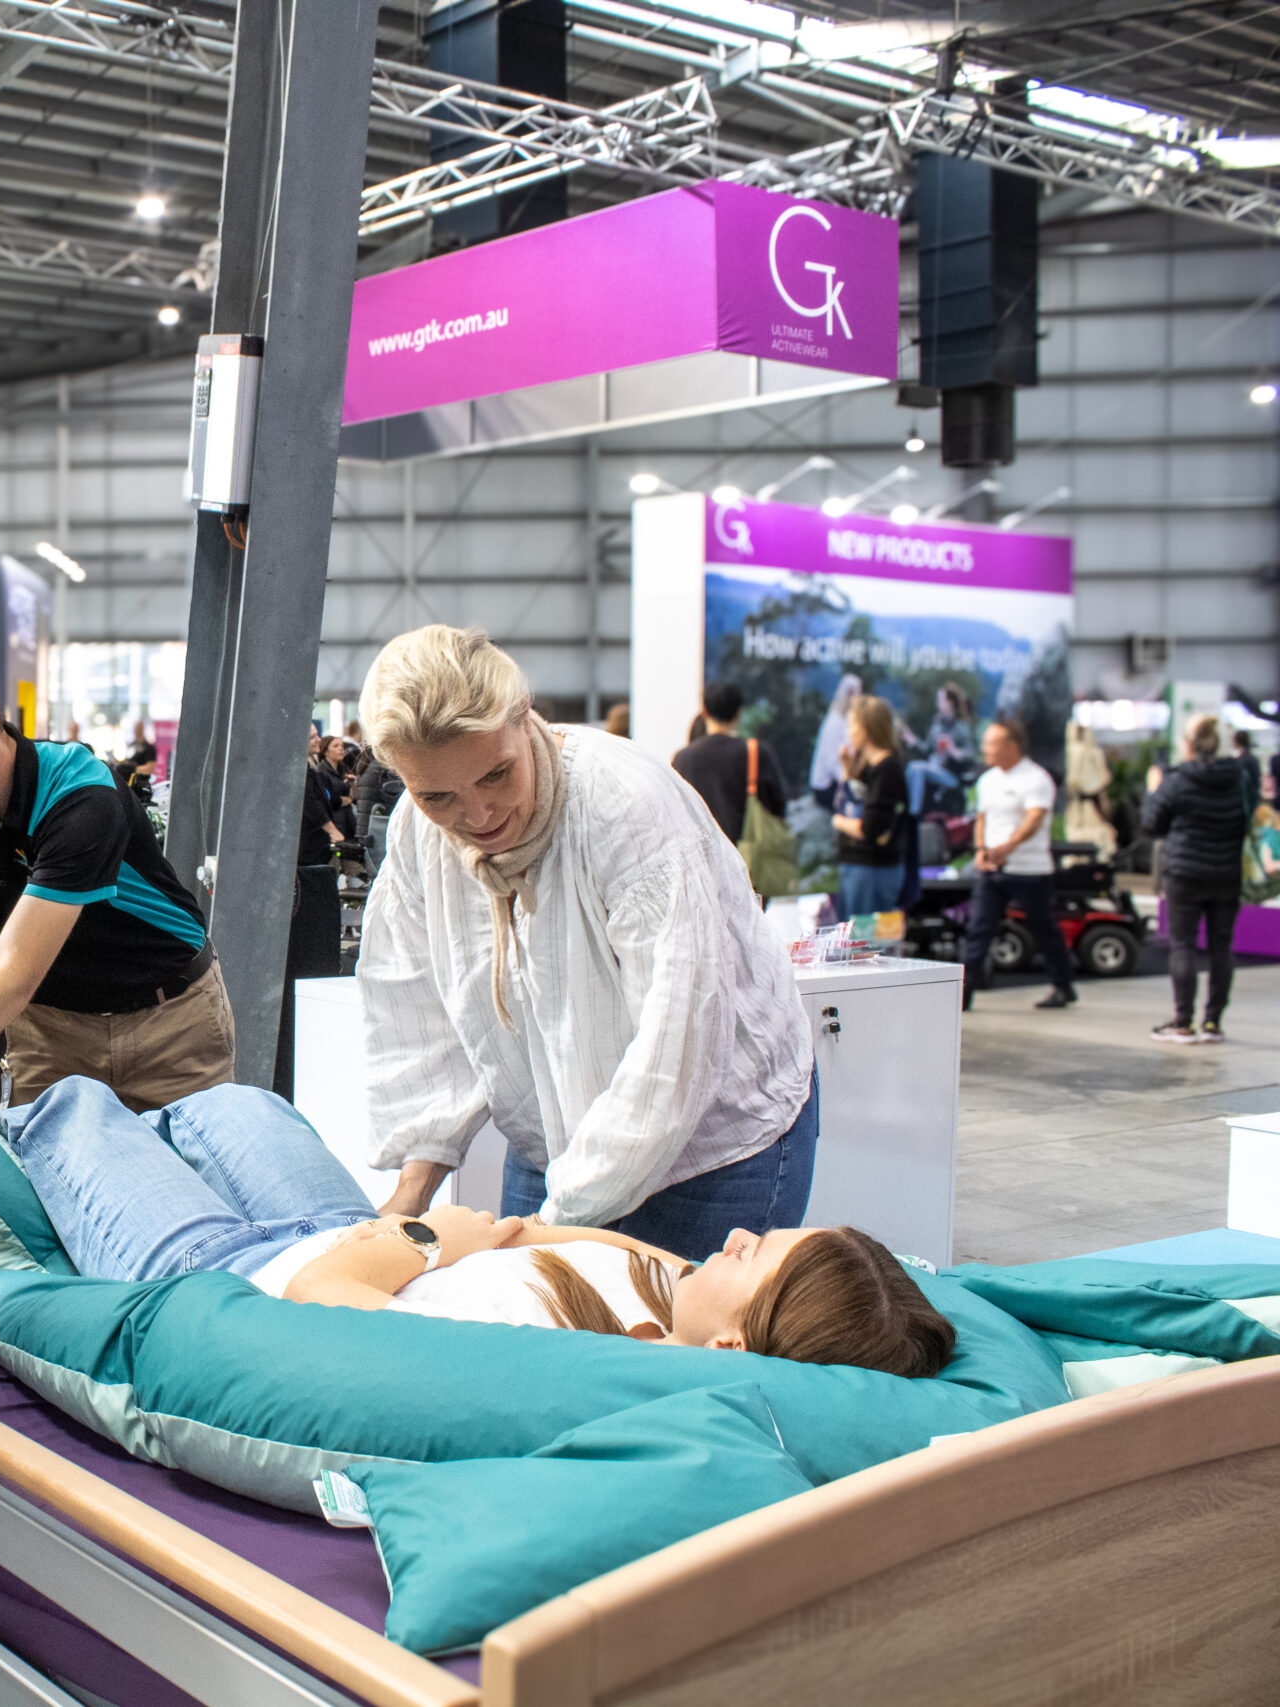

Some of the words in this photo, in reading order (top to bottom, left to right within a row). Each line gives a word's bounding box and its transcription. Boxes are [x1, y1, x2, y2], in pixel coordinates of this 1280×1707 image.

[368, 307, 509, 357] www.gtk.com.au
[771, 323, 814, 342] ULTIMATE
[771, 338, 829, 359] ACTIVEWEAR
[827, 528, 873, 561] NEW
[874, 533, 975, 573] PRODUCTS
[743, 624, 796, 660] How
[799, 634, 866, 666] active
[870, 633, 906, 667] will
[907, 644, 949, 676] you
